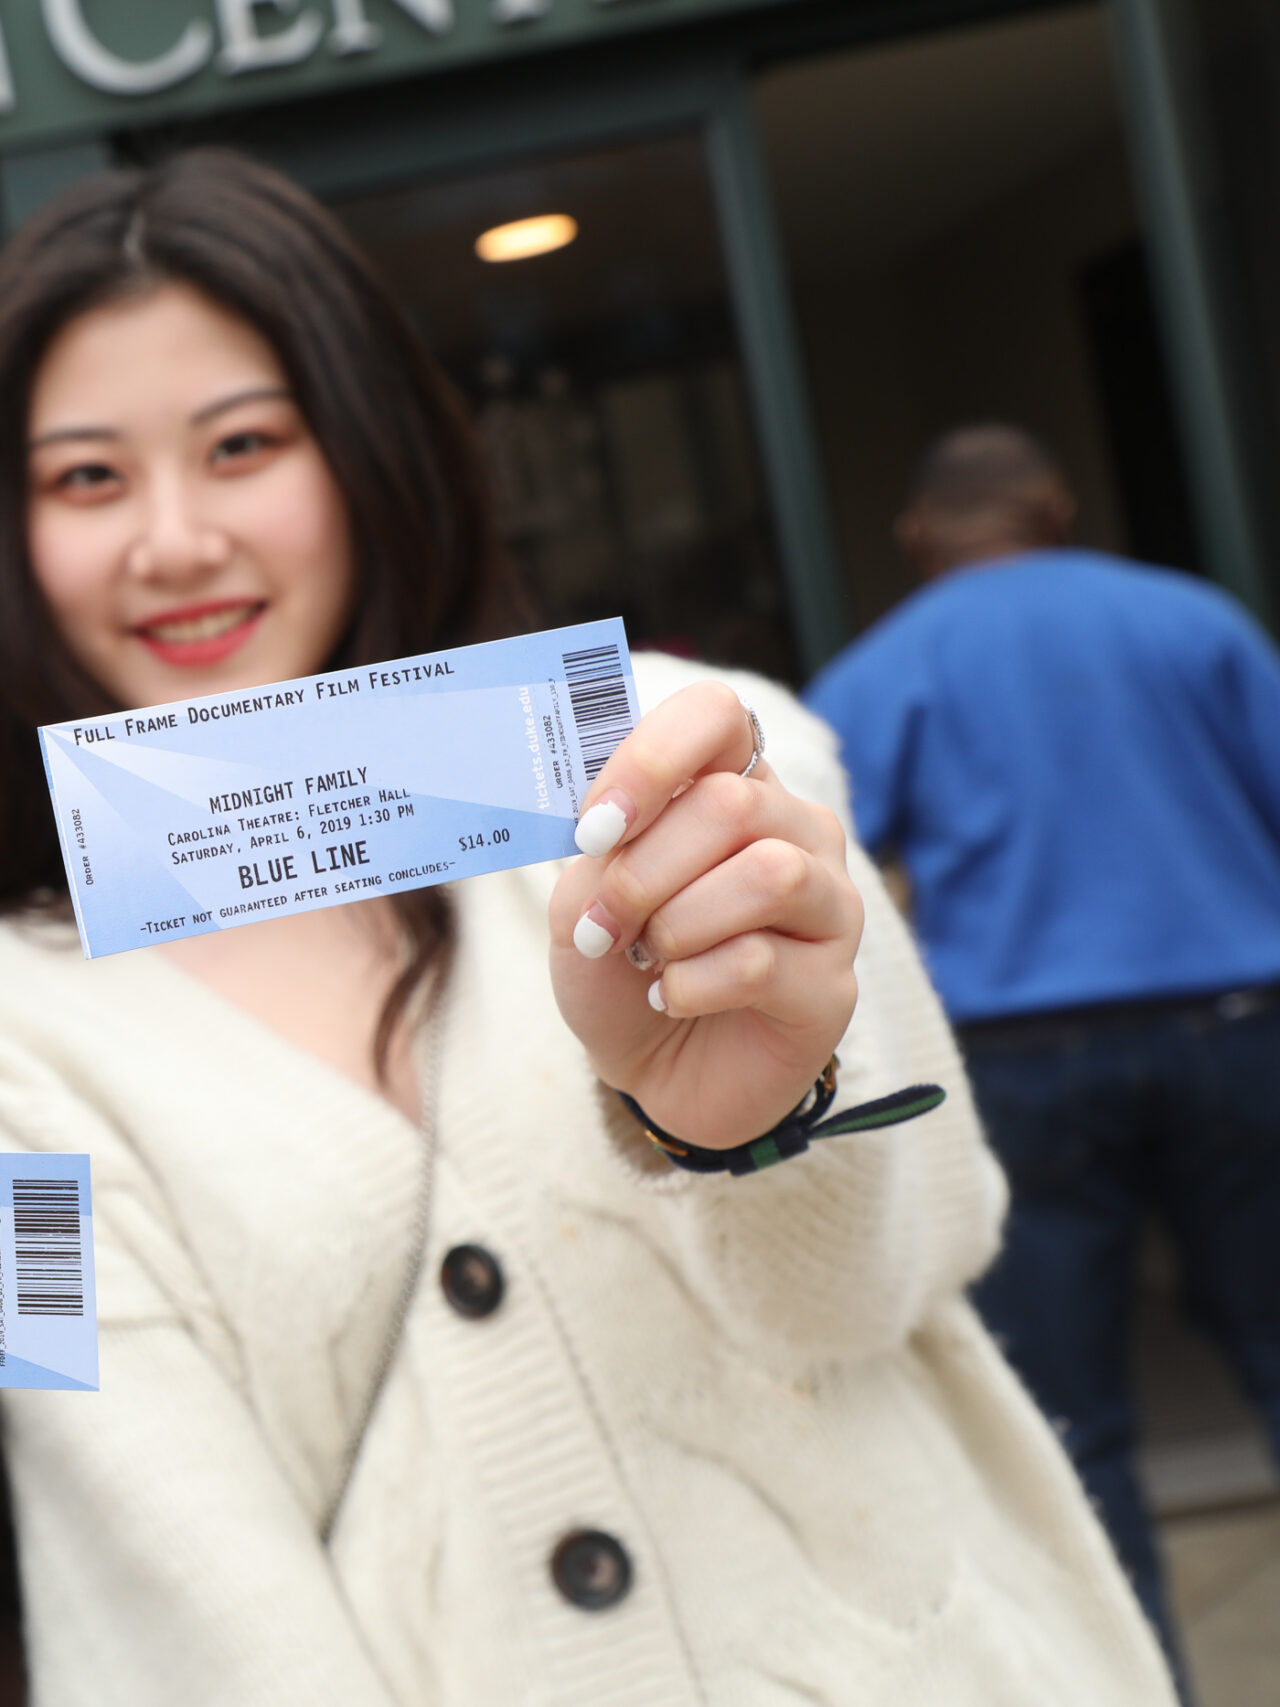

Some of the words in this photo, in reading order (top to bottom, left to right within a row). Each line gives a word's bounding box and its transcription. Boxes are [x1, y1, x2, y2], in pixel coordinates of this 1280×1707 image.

[518, 686, 549, 810] tickets.duke.edu
[542, 714, 558, 754] #433082
[209, 781, 294, 814] MIDNIGHT
[305, 767, 368, 795] FAMILY
[72, 808, 87, 850] #433082
[168, 825, 231, 846] CAROLINA
[296, 826, 311, 841] 6,
[320, 818, 352, 834] 2019
[360, 809, 390, 827] 1:30
[398, 803, 415, 818] PM
[458, 828, 511, 852] $14.00
[83, 856, 94, 885] ORDER
[238, 855, 298, 889] BLUE
[311, 840, 371, 874] LINE
[192, 911, 213, 924] NOT
[219, 895, 288, 918] GUARANTEED
[294, 886, 328, 902] AFTER
[335, 875, 382, 894] SEATING
